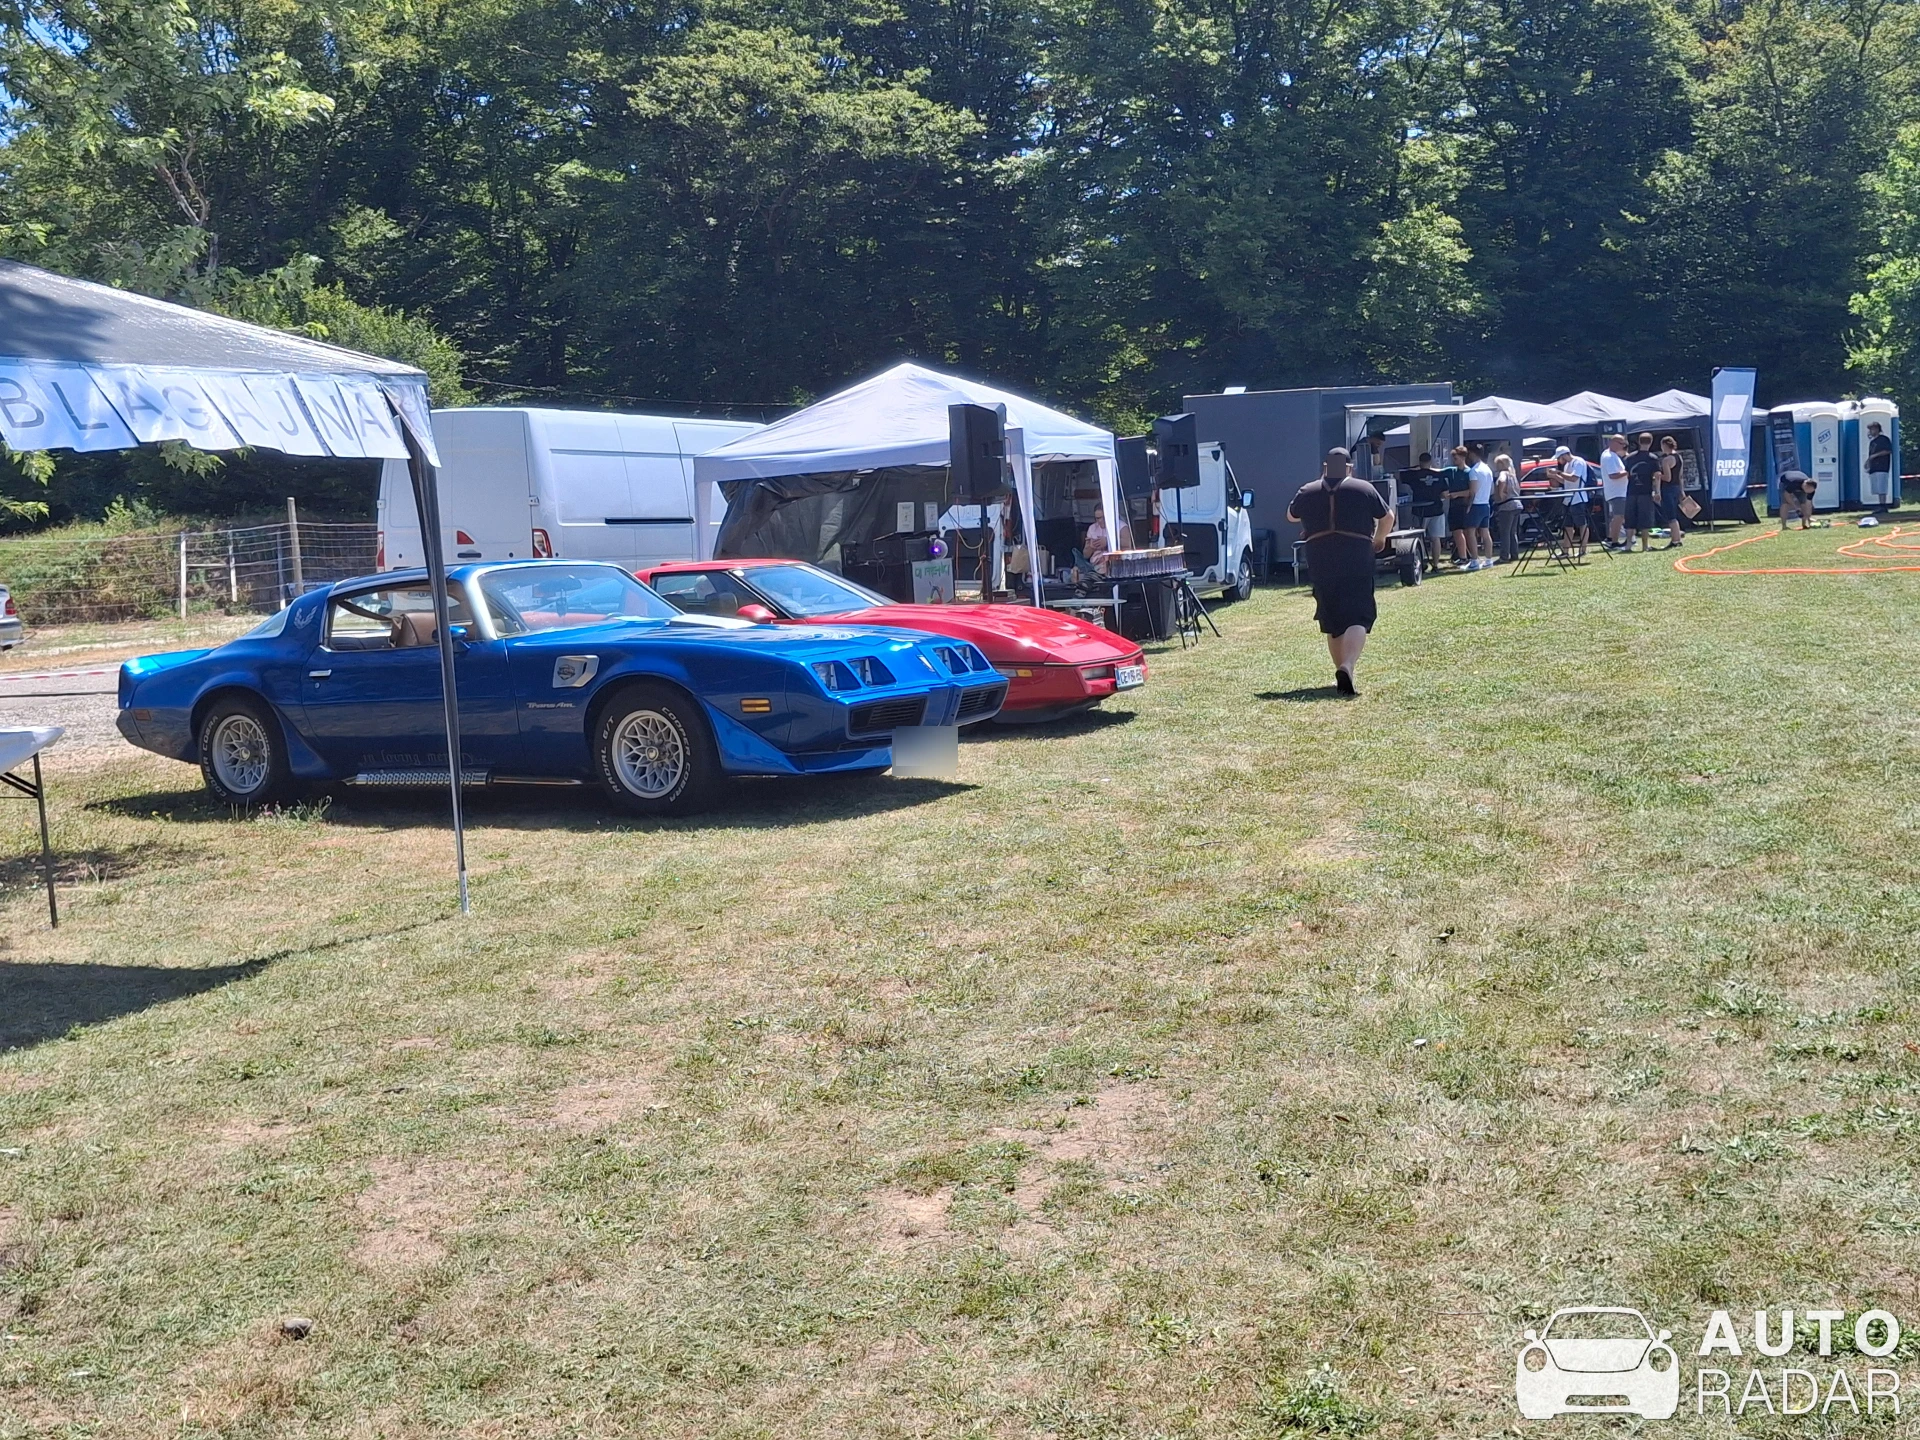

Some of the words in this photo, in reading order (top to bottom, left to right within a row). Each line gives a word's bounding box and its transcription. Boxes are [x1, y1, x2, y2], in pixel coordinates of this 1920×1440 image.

[0, 377, 391, 438] BLAGAJNA
[1716, 468, 1745, 476] TEAM
[202, 715, 218, 751] COBRA
[661, 706, 691, 756] COOPER
[601, 747, 621, 793] RADIAL
[670, 762, 691, 802] COBRA
